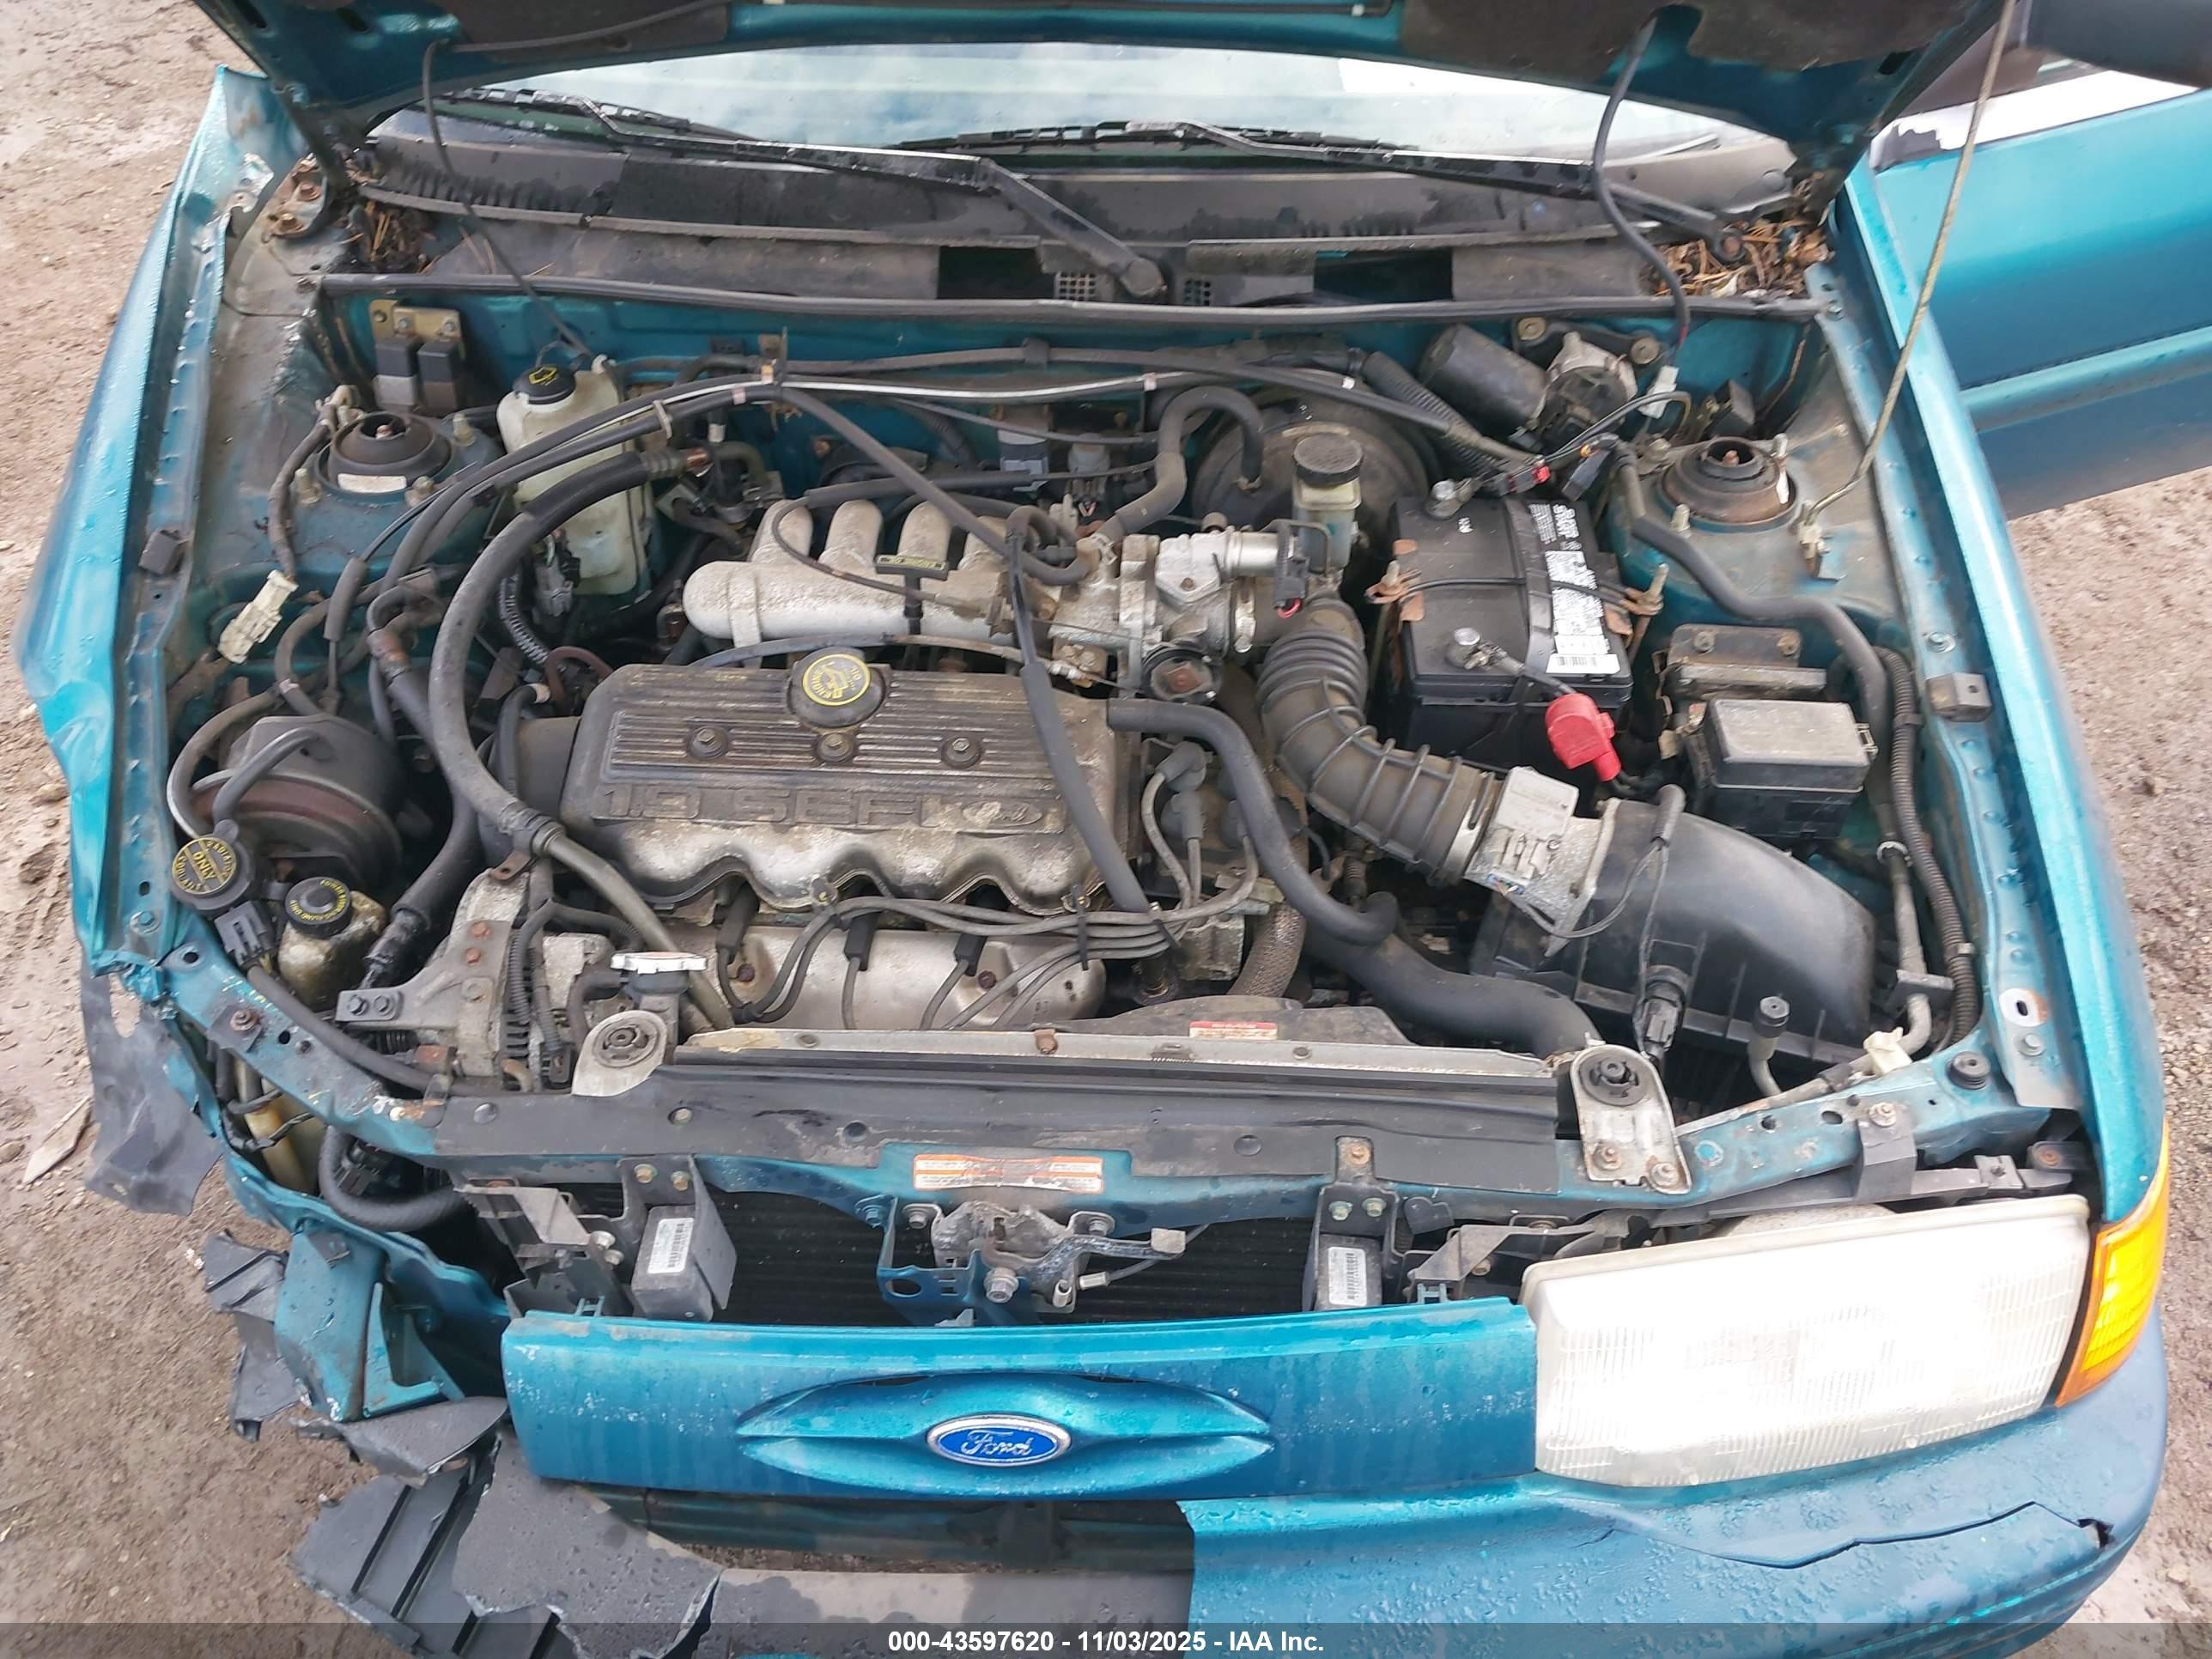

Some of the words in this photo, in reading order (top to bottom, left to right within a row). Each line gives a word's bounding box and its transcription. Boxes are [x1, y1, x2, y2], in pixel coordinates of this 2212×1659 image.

[604, 782, 702, 819] 1.9
[192, 851, 217, 880] ONLY
[961, 1429, 1033, 1456] Ford
